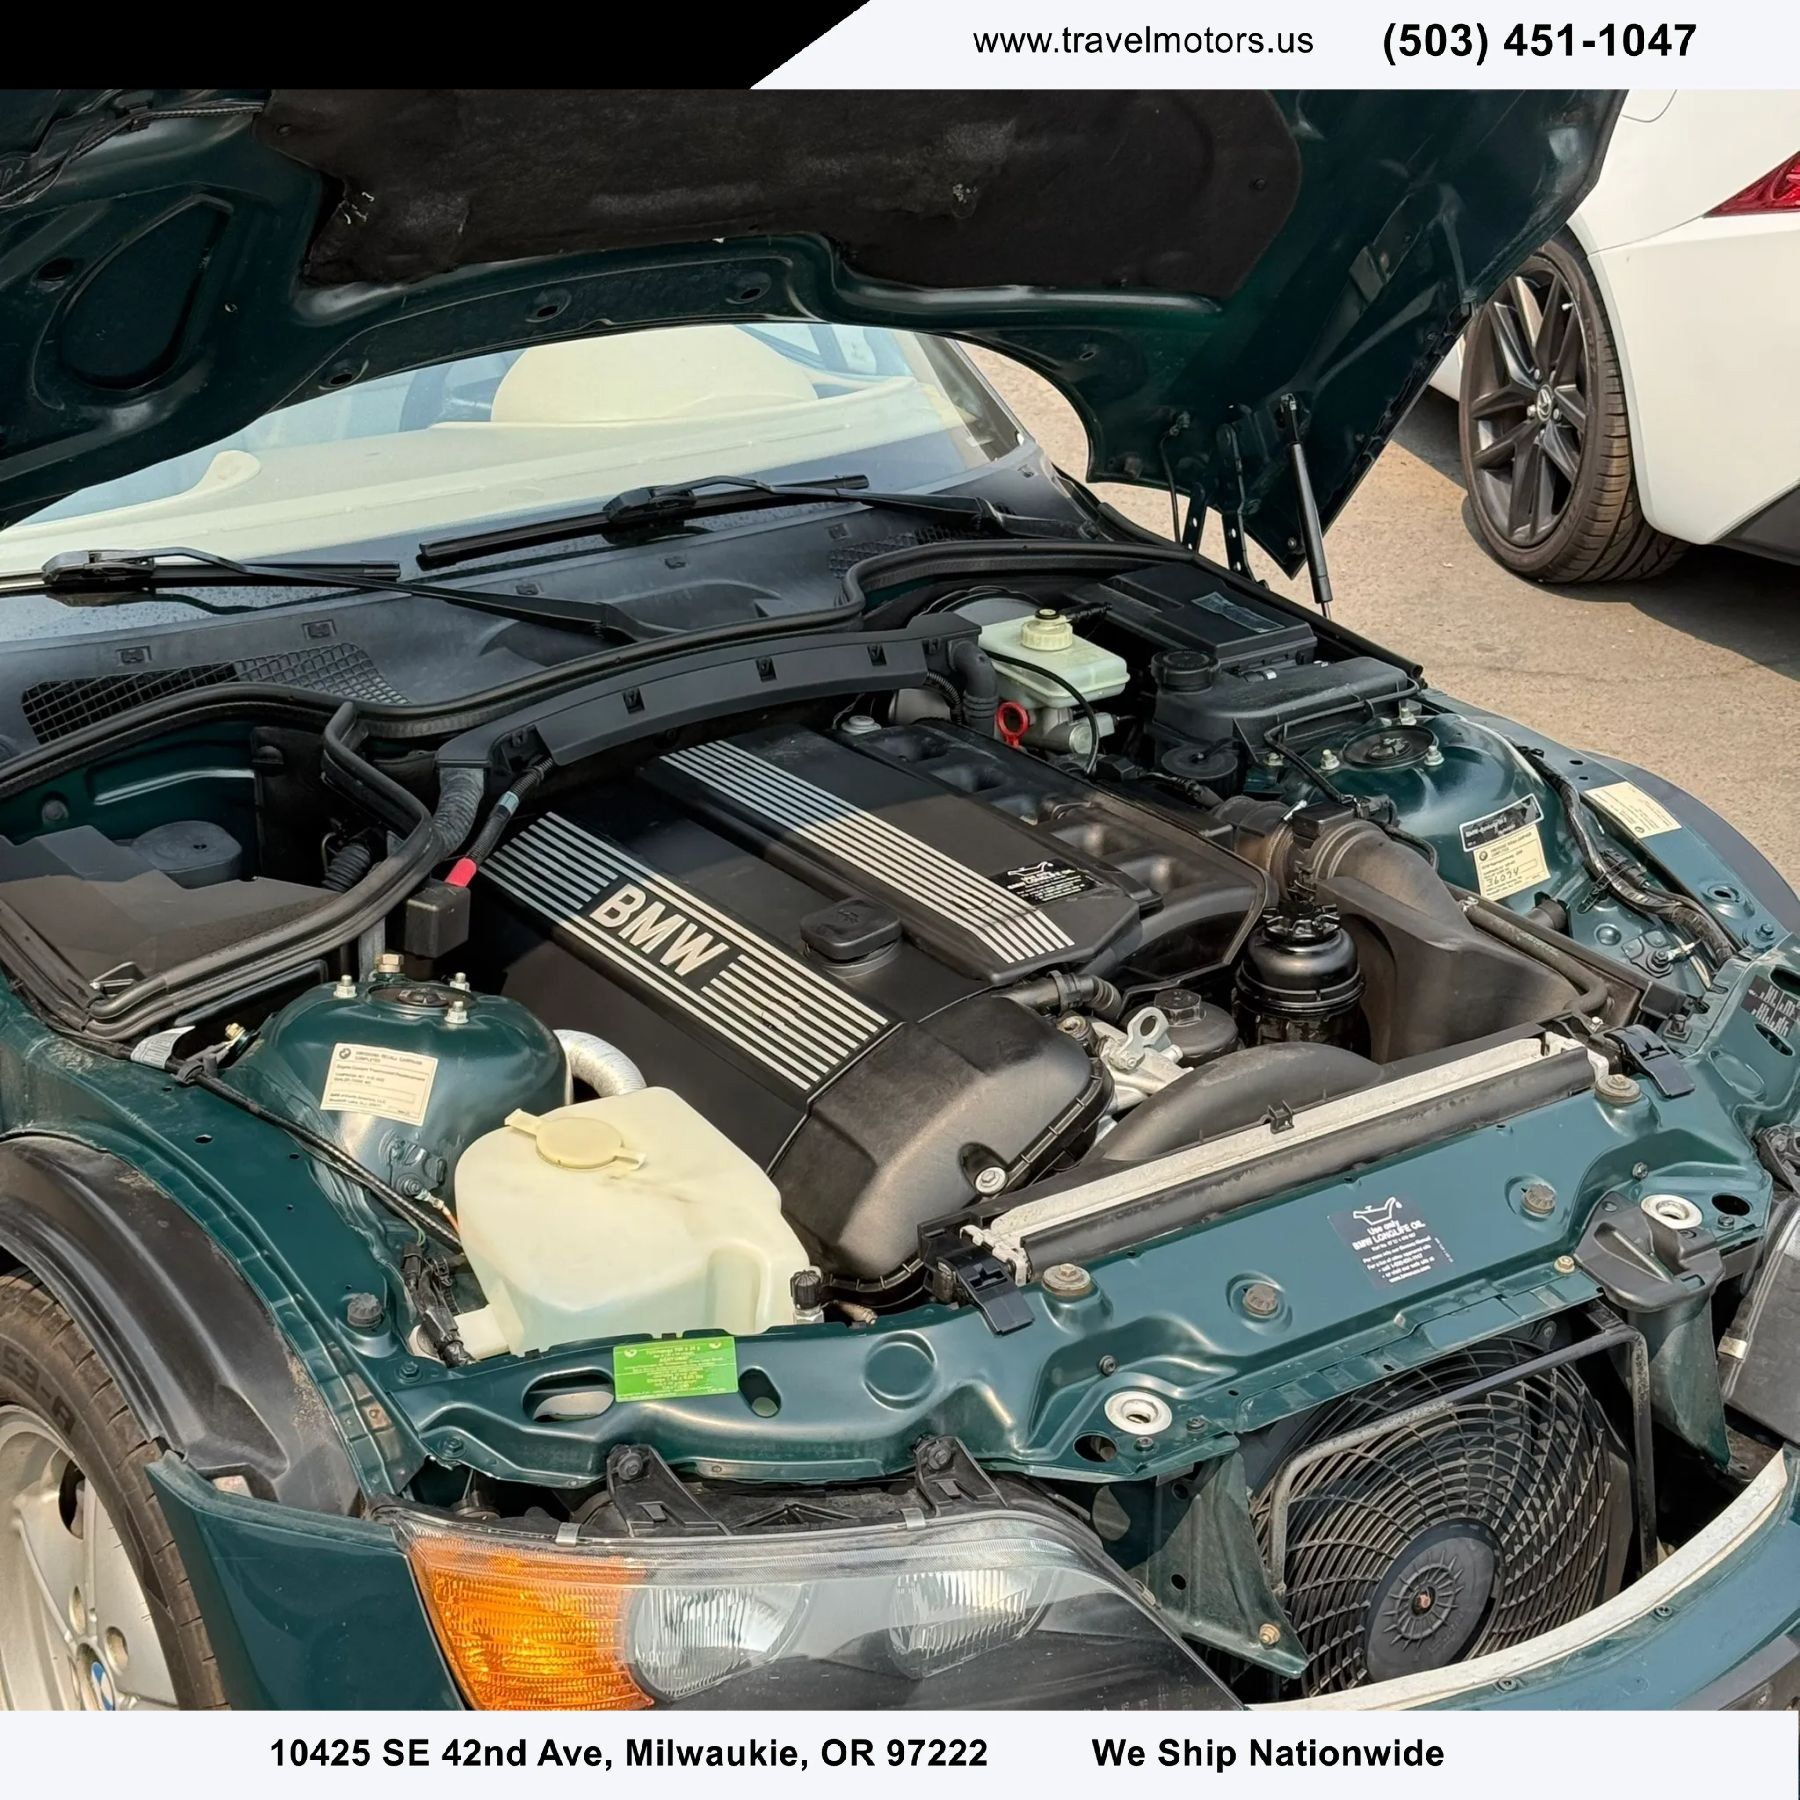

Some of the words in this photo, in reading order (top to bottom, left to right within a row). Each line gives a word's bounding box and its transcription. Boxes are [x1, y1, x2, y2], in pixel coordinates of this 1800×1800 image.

[589, 883, 729, 976] BMW
[1352, 1237, 1374, 1251] BMW
[1372, 1223, 1412, 1244] LONGLIFE
[1367, 1225, 1383, 1236] Use
[1383, 1220, 1401, 1231] only
